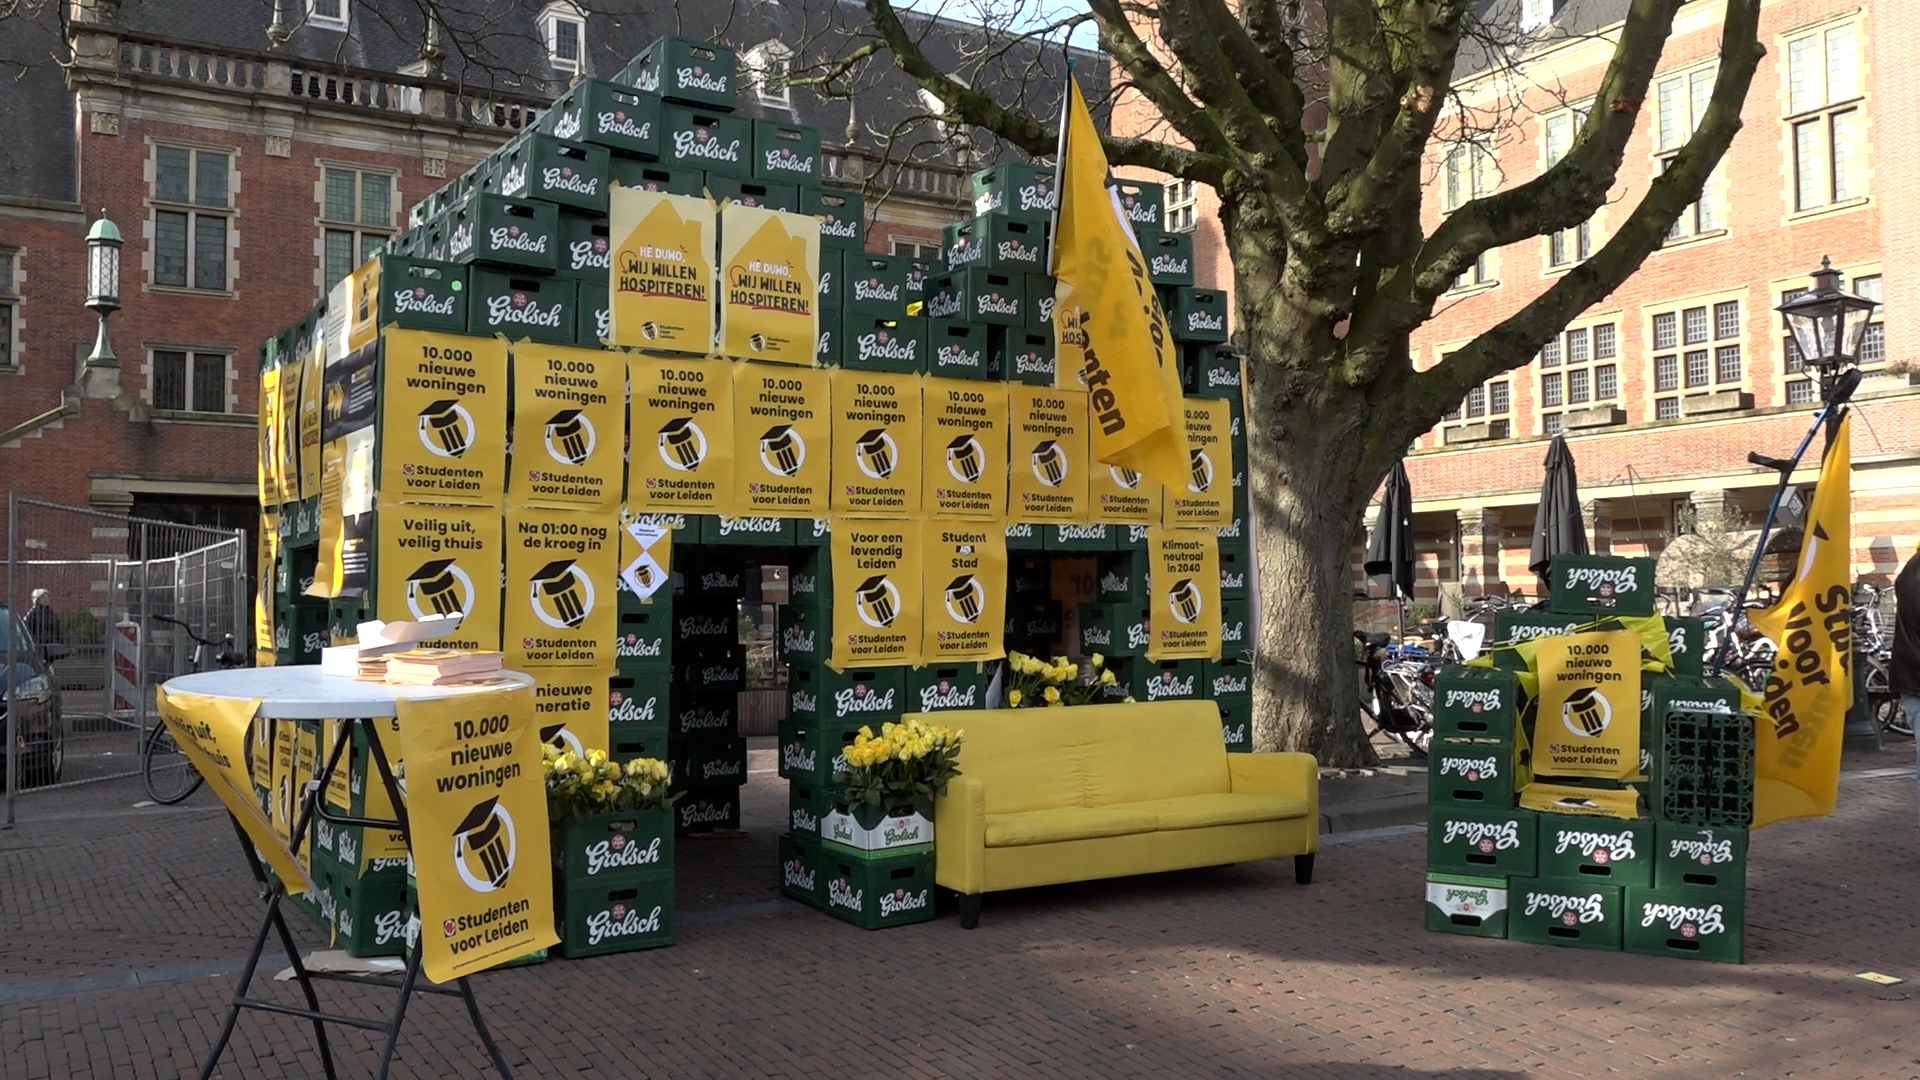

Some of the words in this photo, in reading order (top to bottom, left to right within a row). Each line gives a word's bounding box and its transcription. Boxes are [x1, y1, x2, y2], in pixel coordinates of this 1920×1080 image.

[677, 67, 727, 93] Grolsch
[598, 111, 650, 140] Grolsch
[674, 130, 740, 162] Grolsch
[766, 149, 813, 173] Grolsch
[543, 167, 598, 195] Grolsch
[490, 227, 547, 253] Grolsch
[998, 241, 1037, 262] Grolsch
[629, 260, 648, 275] WIJ
[651, 262, 697, 280] WILLEN
[1151, 257, 1187, 275] Grolsch
[620, 277, 705, 298] HOSPITEREN!
[739, 275, 757, 289] WIJ
[760, 276, 801, 295] WILLEN
[854, 280, 898, 301] Grolsch
[394, 289, 453, 316] Grolsch
[731, 290, 809, 312] HOSPITEREN!
[977, 294, 1018, 315] Grolsch
[488, 296, 562, 328] Grolsch
[1188, 311, 1222, 331] Grolsch
[422, 346, 472, 362] 10.000
[858, 337, 916, 361] Grolsch
[938, 346, 980, 367] Grolsch
[418, 362, 476, 378] nieuwe
[547, 360, 595, 374] 10.000
[545, 374, 598, 388] nieuwe
[660, 369, 704, 382] 10.000
[1208, 369, 1240, 387] Grolsch
[407, 378, 486, 395] woningen
[658, 384, 707, 397] nieuwe
[762, 378, 803, 391] 10.000
[857, 384, 895, 396] 10.000
[535, 388, 606, 406] woningen
[759, 392, 805, 405] nieuwe
[854, 397, 898, 409] nieuwe
[948, 391, 984, 403] 10.000
[1032, 398, 1065, 409] 10.000
[648, 397, 715, 414] woningen
[750, 405, 814, 420] woningen
[946, 404, 986, 416] nieuwe
[846, 411, 906, 425] woningen
[1029, 410, 1067, 422] nieuwe
[937, 417, 993, 431] woningen
[1022, 423, 1074, 436] woningen
[1187, 433, 1218, 445] ningen
[417, 465, 483, 479] Studenten
[541, 472, 603, 486] Studenten
[407, 480, 436, 488] voor
[439, 479, 480, 491] Leiden
[532, 486, 560, 494] voor
[562, 485, 601, 497] Leiden
[658, 479, 715, 489] Studenten
[759, 484, 812, 494] Studenten
[855, 486, 905, 496] Studenten
[649, 490, 675, 500] voor
[677, 490, 713, 501] Leiden
[752, 496, 776, 504] voor
[778, 494, 810, 505] Leiden
[849, 497, 871, 505] voor
[873, 497, 904, 506] Leiden
[946, 490, 992, 500] Studenten
[1031, 494, 1074, 503] Studenten
[1109, 496, 1149, 504] Studenten
[940, 501, 960, 509] voor
[961, 501, 990, 510] Leiden
[1025, 504, 1044, 512] voor
[1046, 504, 1072, 513] Leiden
[1122, 506, 1148, 514] Leiden
[404, 519, 447, 534] Veilig
[450, 521, 476, 534] uit,
[519, 523, 538, 534] Na
[541, 524, 578, 535] 01:00
[581, 526, 607, 539] nog
[398, 536, 442, 551] veilig
[444, 537, 483, 550] thuis
[523, 537, 541, 549] de
[544, 537, 585, 552] kroeg
[588, 538, 601, 550] in
[850, 533, 879, 543] Voor
[882, 534, 903, 543] een
[942, 532, 986, 543] Student
[1162, 540, 1204, 550] Klimaat-
[850, 545, 902, 558] levendig
[1163, 551, 1204, 562] neutraal
[857, 558, 896, 569] Leiden
[951, 558, 978, 568] Stad
[1167, 564, 1176, 573] in
[1178, 564, 1200, 573] 2040
[1566, 565, 1638, 593] Grolsch
[680, 617, 729, 639] Grolsch
[946, 630, 990, 640] Studenten
[1169, 630, 1208, 638] Studenten
[418, 639, 478, 649] tudenten
[536, 638, 597, 648] Studenten
[784, 628, 815, 654] Grolsch
[858, 634, 906, 643] Studenten
[939, 642, 960, 650] voor
[961, 641, 988, 649] Leiden
[1163, 640, 1180, 648] voor
[1181, 639, 1207, 647] Leiden
[526, 651, 553, 660] voor
[555, 650, 594, 660] Leiden
[851, 646, 872, 654] voor
[873, 644, 904, 654] Leiden
[1567, 644, 1609, 655] 10.000
[1565, 657, 1612, 668] nieuwe
[702, 667, 739, 684] Grolsch
[1557, 671, 1622, 684] woningen
[536, 684, 593, 697] nieuwe
[1147, 675, 1195, 700] Grolsch
[1213, 677, 1247, 696] Grolsch
[535, 698, 591, 713] neratie
[836, 688, 895, 717] Grolsch
[920, 684, 976, 713] Grolsch
[1445, 689, 1501, 711] Grolsch
[454, 714, 509, 741] 10.000
[680, 709, 729, 733] Grolsch
[451, 742, 513, 766] nieuwe
[1561, 744, 1620, 755] Studenten
[783, 744, 816, 772] Grolsch
[1553, 756, 1578, 764] voor
[1580, 755, 1618, 766] Leiden
[703, 761, 740, 779] Grolsch
[1440, 757, 1498, 779] Grolsch
[437, 762, 521, 793] woningen
[681, 802, 731, 827] Grolsch
[1443, 820, 1520, 850] Grolsch
[1555, 830, 1635, 860] Grolsch
[1669, 838, 1734, 862] Grolsch
[586, 838, 661, 875] Grolsch
[784, 860, 815, 892] Grolsch
[828, 879, 863, 912] Grolsch
[880, 889, 928, 917] Grolsch
[458, 899, 530, 932] Studenten
[1525, 892, 1604, 924] Grolsch
[586, 906, 662, 945] Grolsch
[1642, 902, 1725, 935] Grolsch
[450, 933, 482, 955] voor
[485, 917, 529, 942] Leiden
